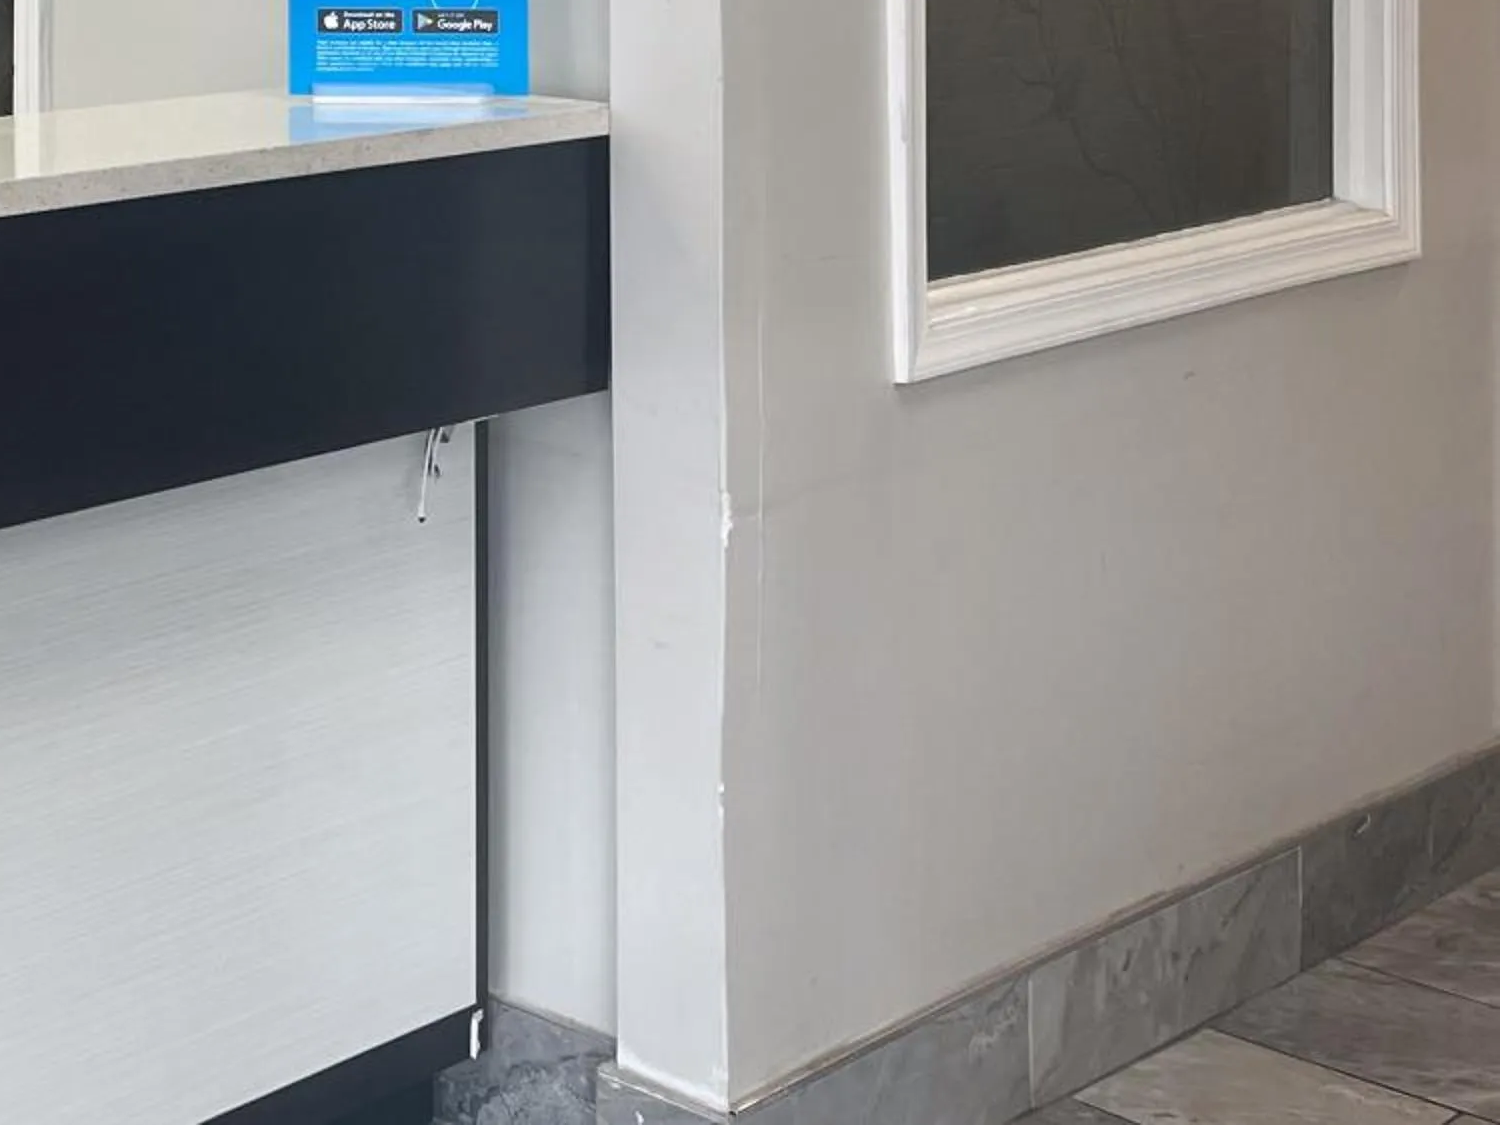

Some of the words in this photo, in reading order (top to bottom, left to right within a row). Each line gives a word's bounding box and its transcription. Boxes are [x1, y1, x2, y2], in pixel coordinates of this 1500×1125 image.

[343, 19, 367, 31] App
[367, 18, 396, 30] Store
[437, 18, 472, 32] Google
[473, 18, 493, 32] Play
